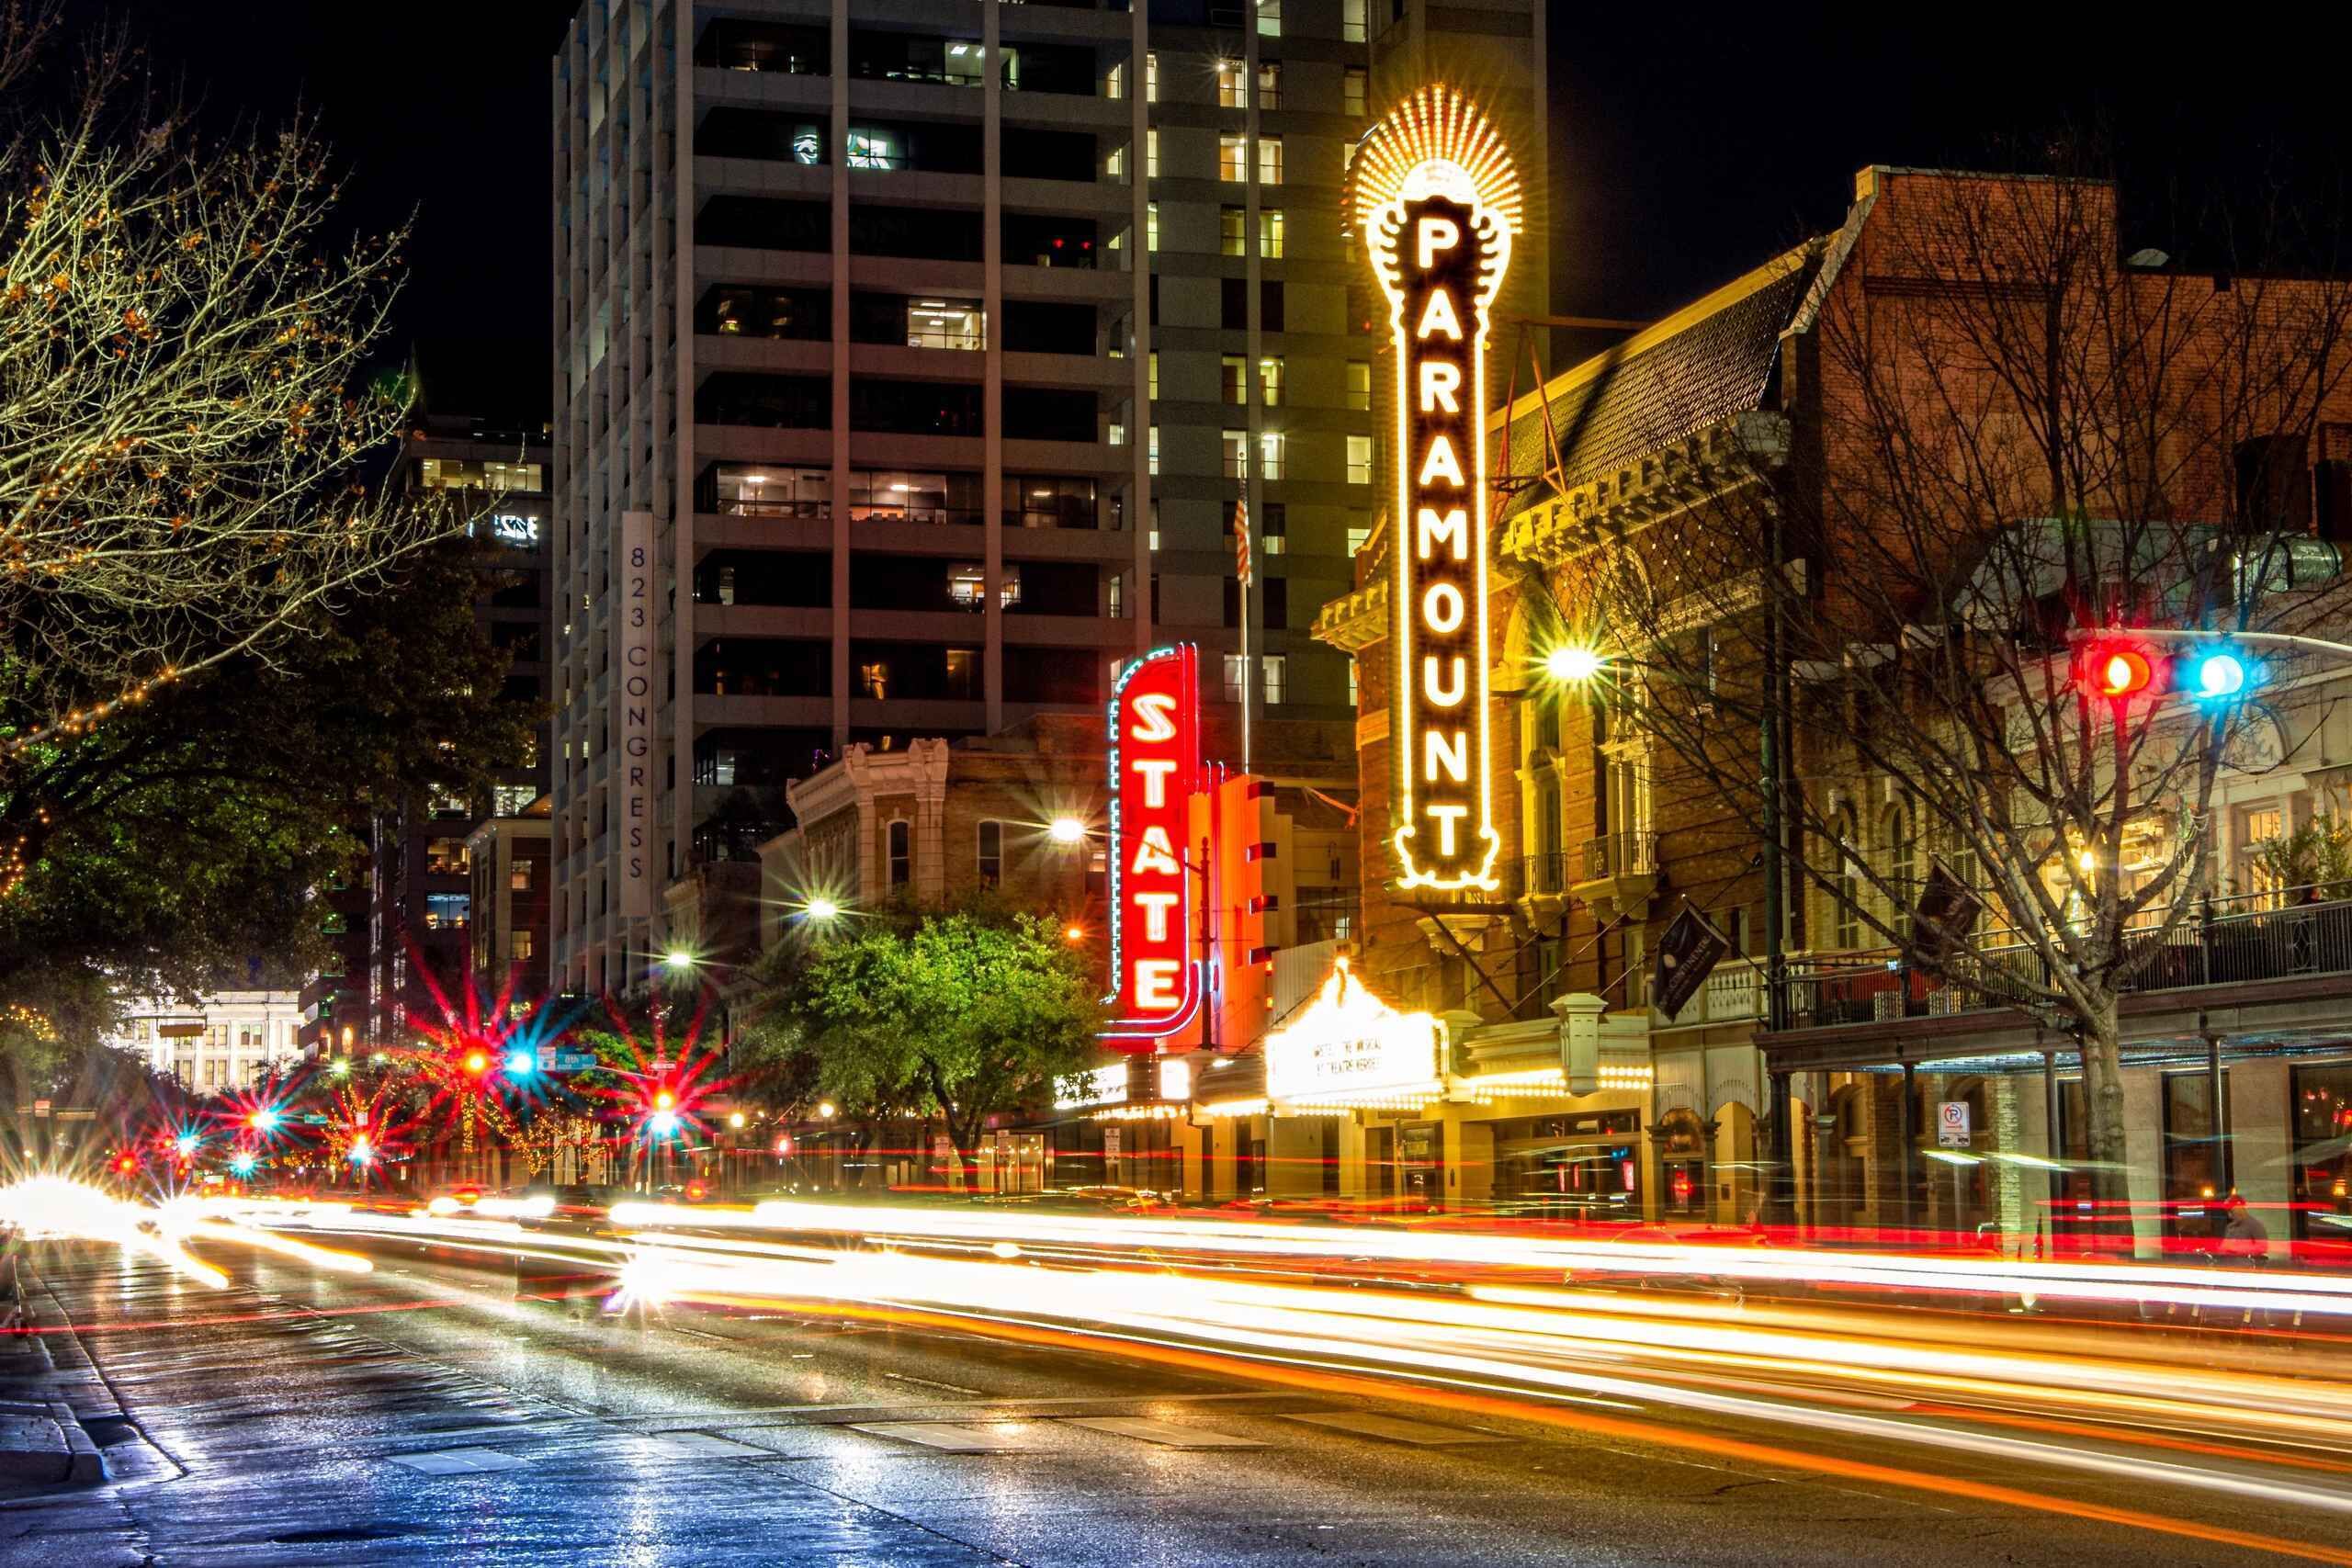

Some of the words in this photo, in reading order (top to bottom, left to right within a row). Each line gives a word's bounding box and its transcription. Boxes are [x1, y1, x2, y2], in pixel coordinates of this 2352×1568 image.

[630, 547, 645, 628] 823
[1417, 217, 1468, 856] PARAMOUNT
[627, 646, 649, 879] CONGRESS
[1131, 693, 1181, 1009] STATE
